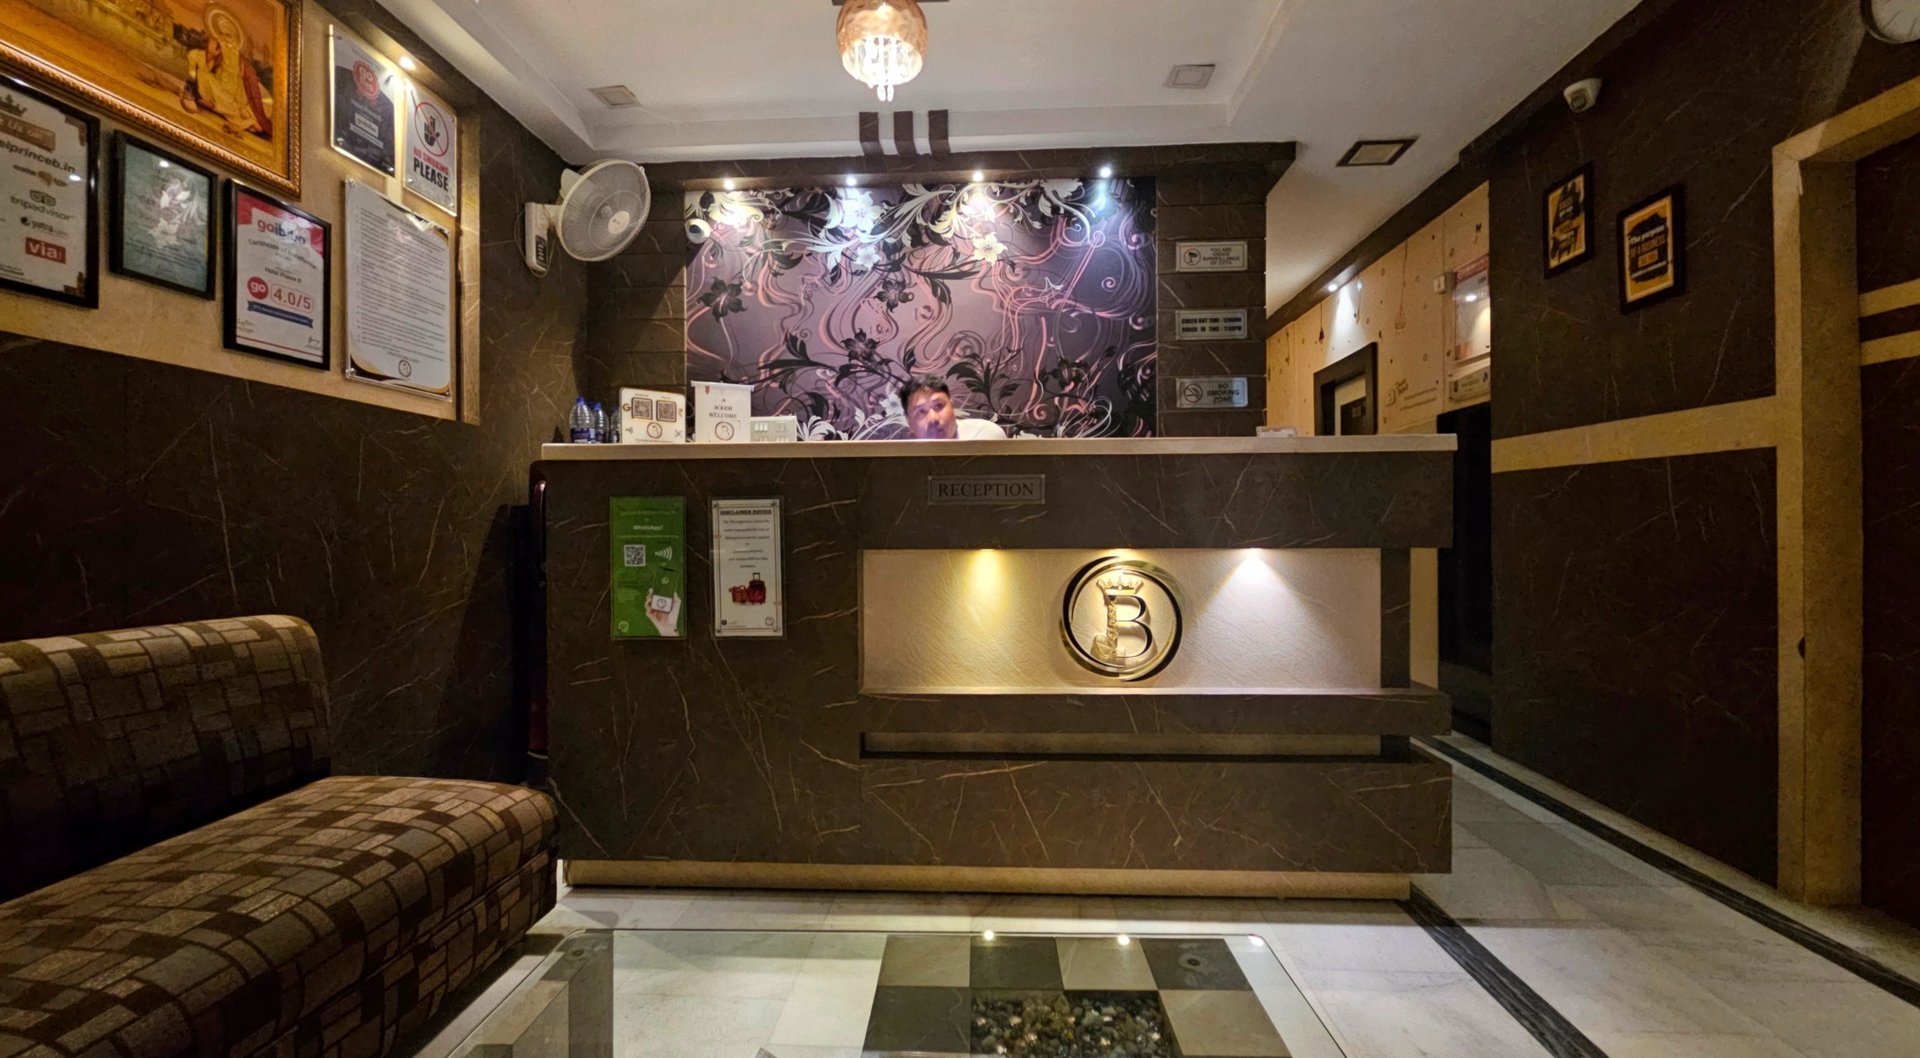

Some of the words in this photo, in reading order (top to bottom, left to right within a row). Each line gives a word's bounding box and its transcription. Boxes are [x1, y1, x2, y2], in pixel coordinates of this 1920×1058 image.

[413, 157, 449, 192] PLEASE
[423, 152, 449, 176] SMOKING
[28, 240, 57, 260] via
[250, 281, 266, 293] go
[273, 287, 312, 310] 4.0/5
[938, 482, 1034, 497] RECEPTION
